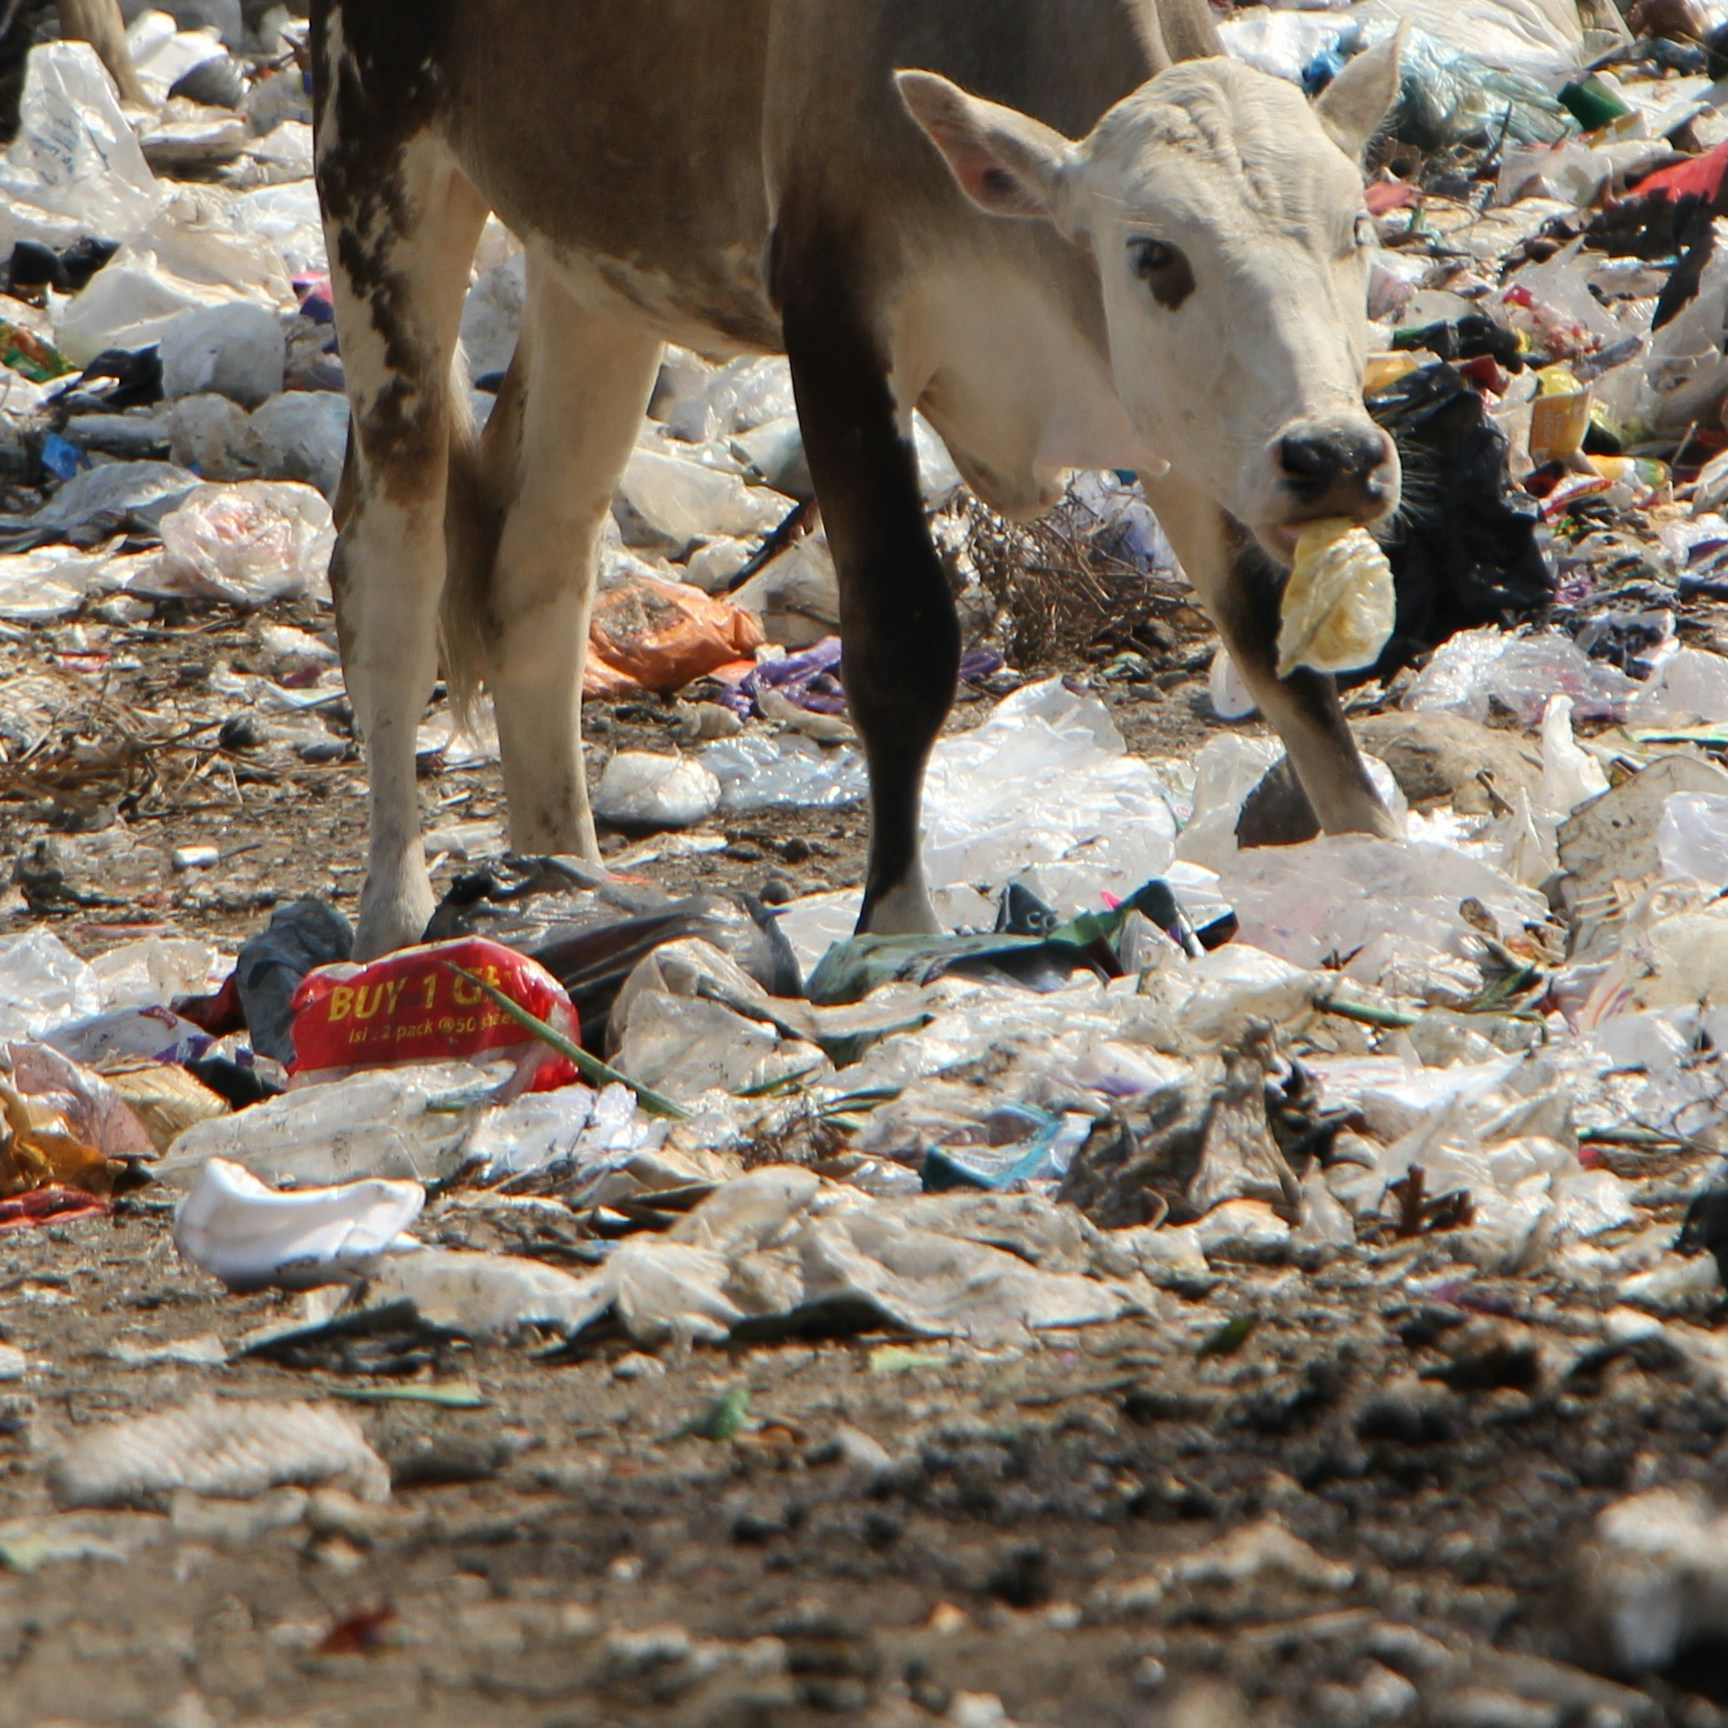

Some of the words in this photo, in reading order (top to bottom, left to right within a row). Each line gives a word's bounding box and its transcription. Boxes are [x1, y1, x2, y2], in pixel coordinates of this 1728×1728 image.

[328, 976, 409, 1022] BUY
[424, 973, 437, 1009] 1
[397, 1019, 433, 1042] pack
